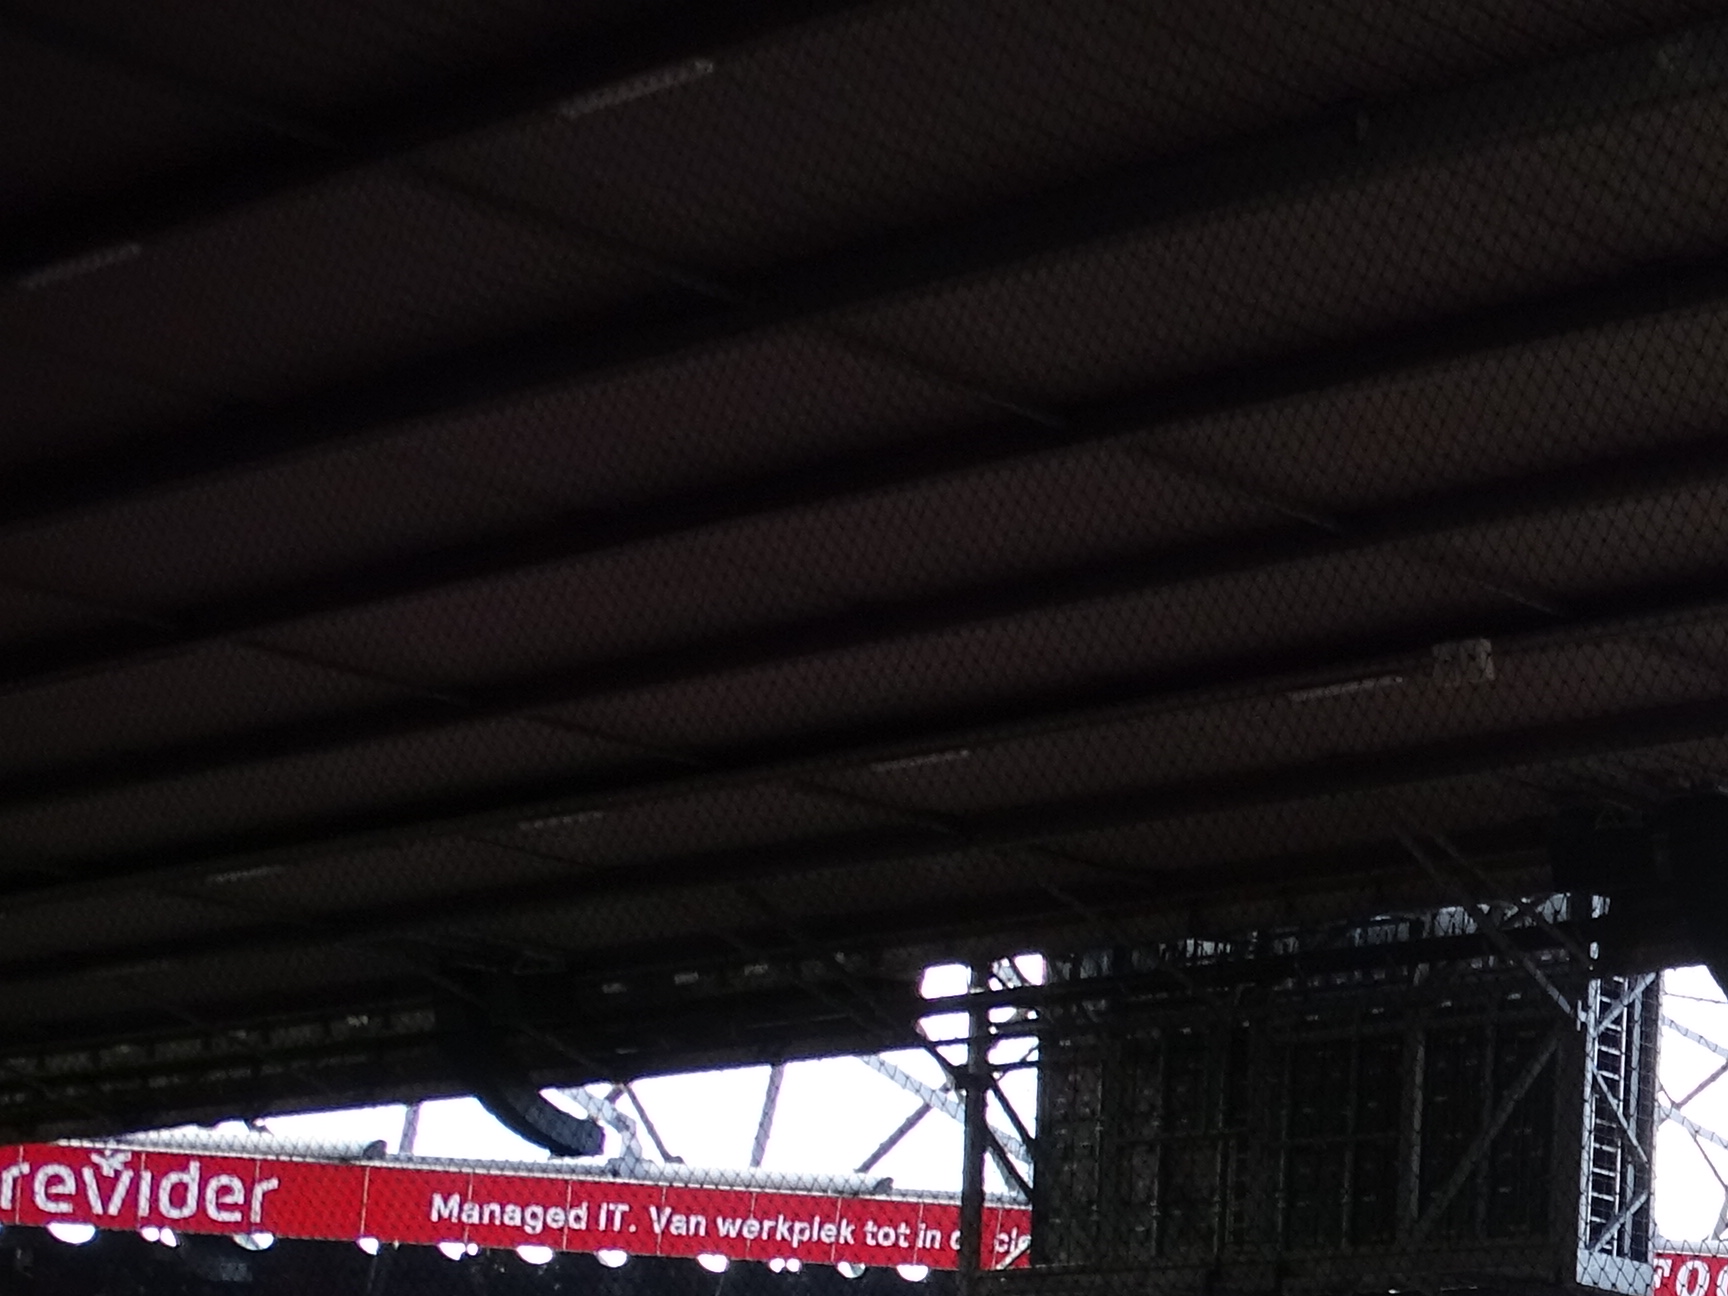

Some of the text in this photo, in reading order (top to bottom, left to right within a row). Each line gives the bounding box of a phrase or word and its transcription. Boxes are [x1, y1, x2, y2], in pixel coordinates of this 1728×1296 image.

[431, 1192, 587, 1235] Managed
[598, 1203, 637, 1233] IT.
[649, 1205, 706, 1237] Van
[716, 1211, 855, 1247] werkplek
[863, 1220, 911, 1250] tot
[916, 1223, 942, 1250] in
